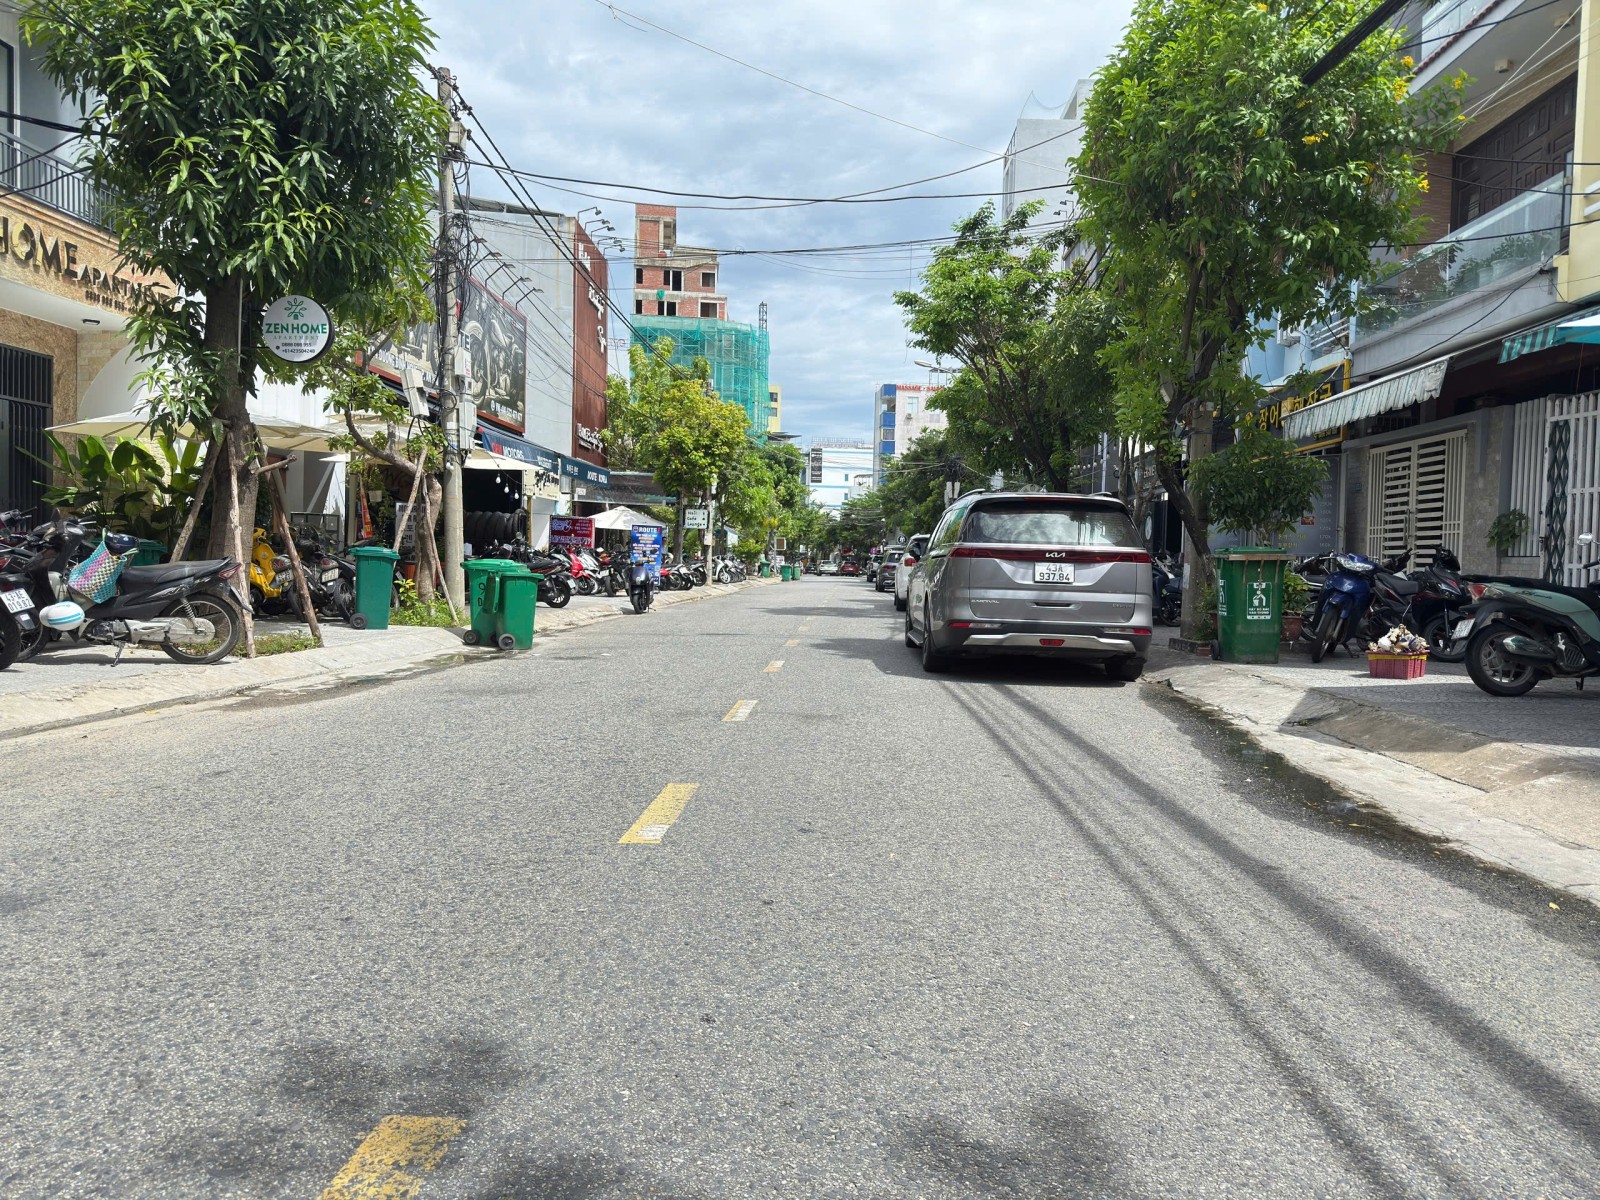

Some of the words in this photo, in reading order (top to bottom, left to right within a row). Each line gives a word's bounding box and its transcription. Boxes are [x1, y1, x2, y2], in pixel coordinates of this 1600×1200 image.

[265, 323, 289, 334] ZEN
[291, 323, 327, 334] HOME
[1046, 563, 1063, 573] 43A
[1039, 572, 1070, 582] 937.84
